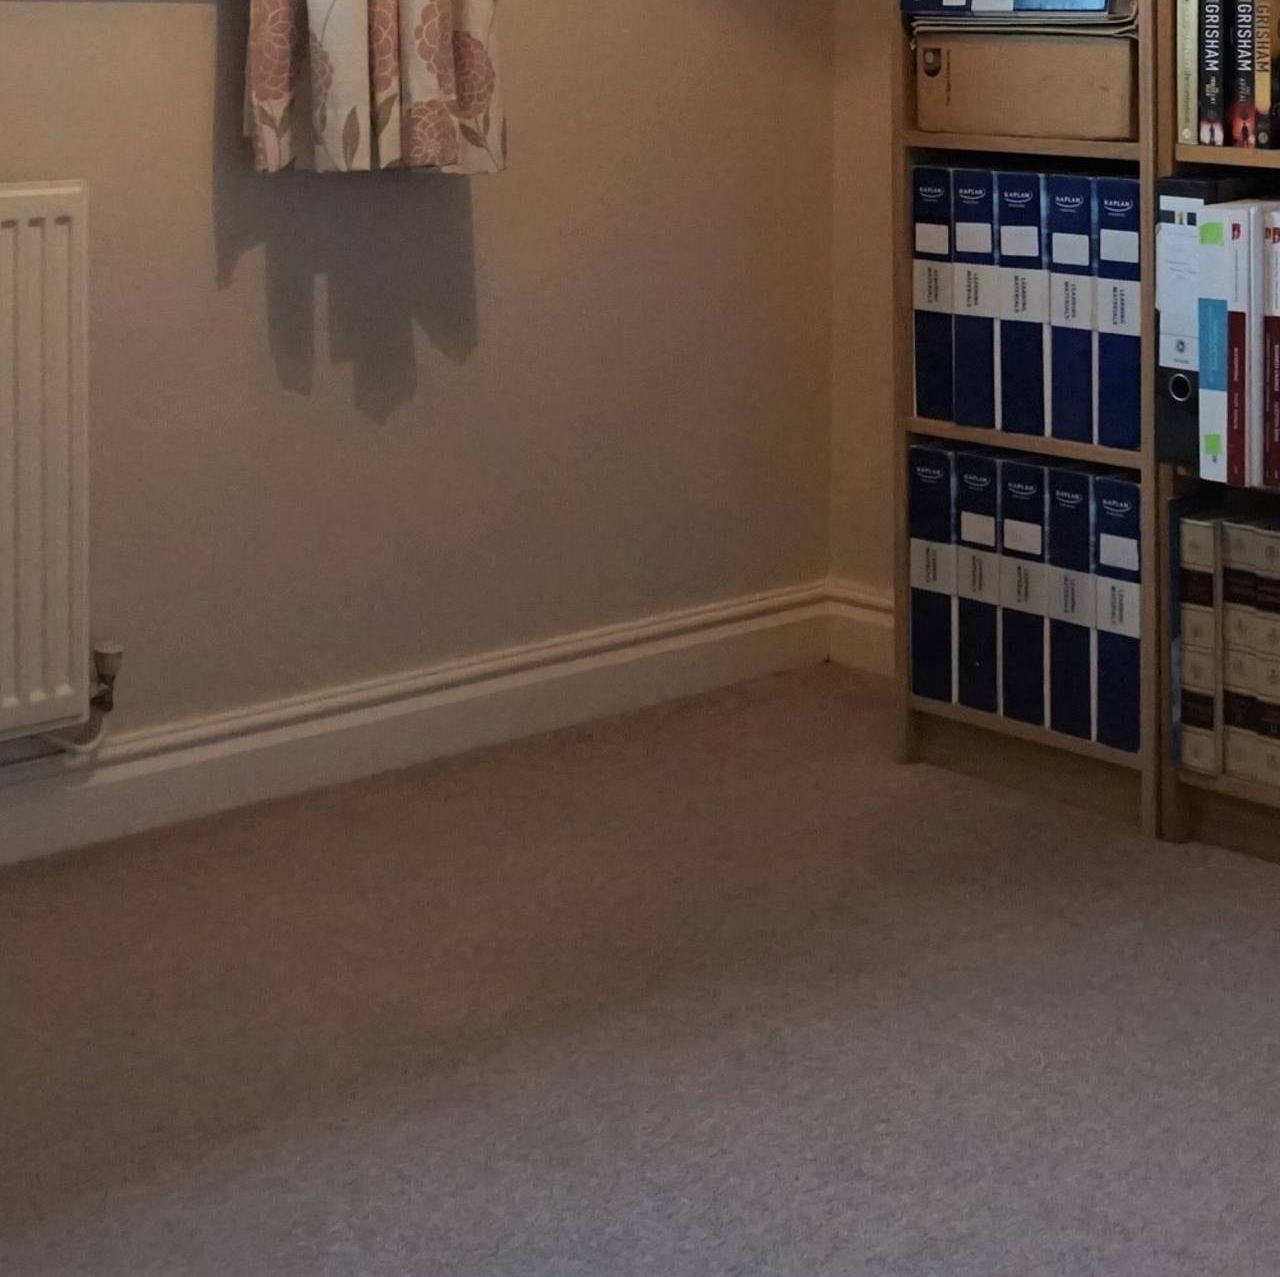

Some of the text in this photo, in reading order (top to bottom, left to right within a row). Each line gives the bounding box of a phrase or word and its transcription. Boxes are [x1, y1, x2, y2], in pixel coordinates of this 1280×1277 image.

[1204, 3, 1220, 72] GRISHAM
[1237, 3, 1253, 72] GRISHAM
[1255, 4, 1270, 73] GRISHAM
[958, 187, 985, 198] KAPLAN
[1004, 190, 1032, 200] KAPLAN
[1055, 195, 1082, 206] KAPLAN
[1104, 199, 1131, 209] KAPLAN
[1008, 482, 1035, 492] KAPLAN
[1055, 490, 1080, 500] KAPLAN
[1103, 499, 1129, 509] KAPLAN
